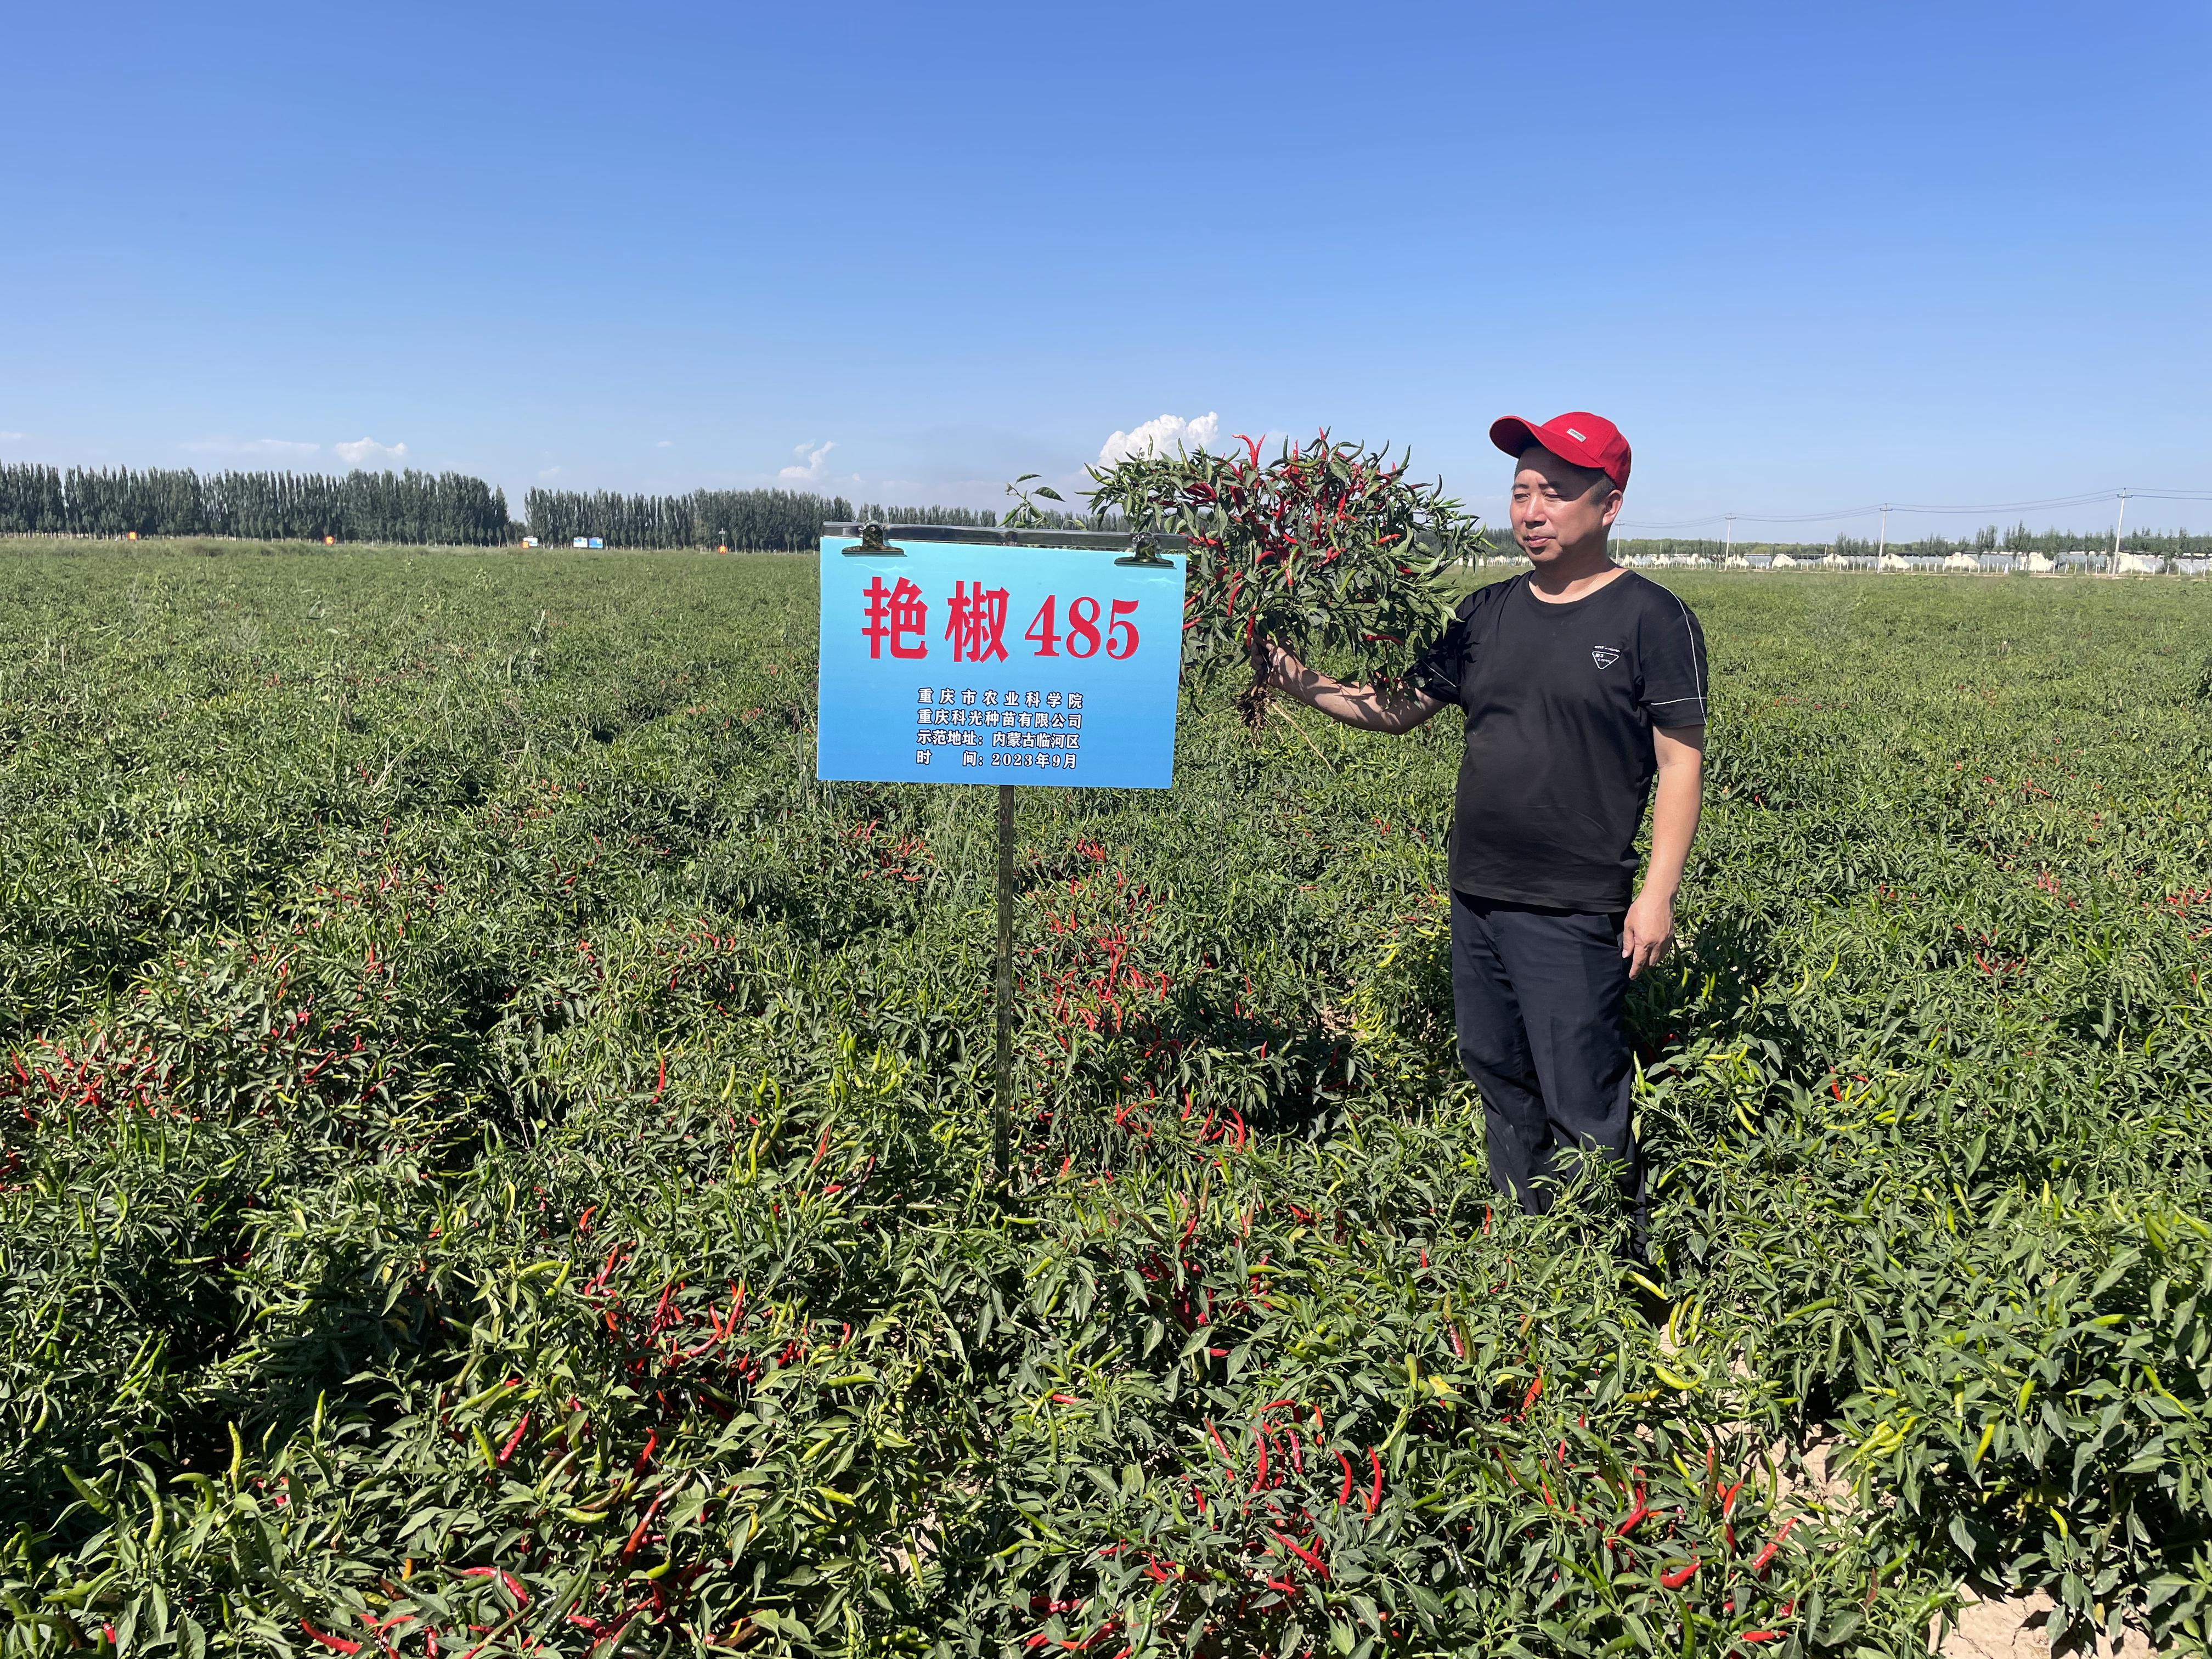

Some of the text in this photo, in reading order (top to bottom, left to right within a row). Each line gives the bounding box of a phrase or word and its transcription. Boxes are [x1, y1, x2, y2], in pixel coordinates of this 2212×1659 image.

[861, 576, 1139, 663] 艳椒485
[917, 687, 1084, 709] 重庆市农业科学院
[917, 708, 1082, 729] 重庆科光种苗有限公司
